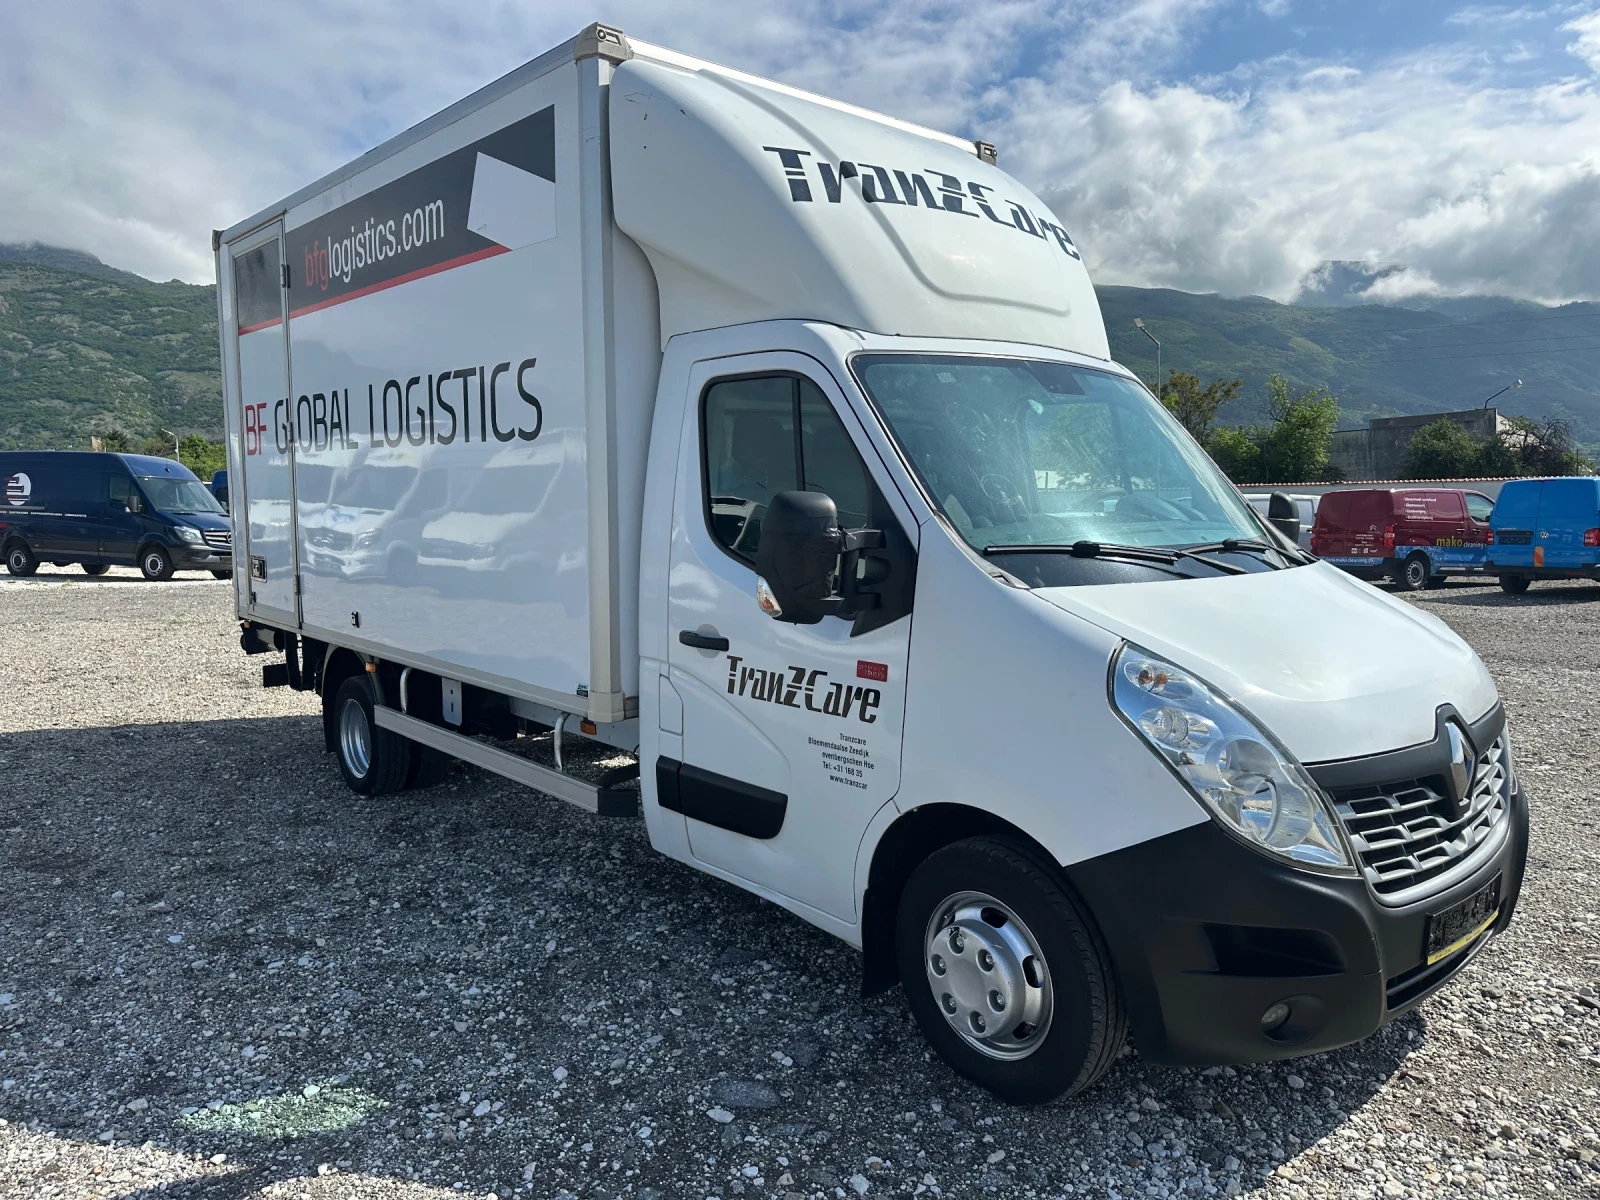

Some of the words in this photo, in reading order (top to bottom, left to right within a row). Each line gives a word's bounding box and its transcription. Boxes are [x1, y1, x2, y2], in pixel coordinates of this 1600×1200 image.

[304, 198, 445, 291] bfglogistics.com
[244, 402, 268, 456] BF
[368, 357, 544, 449] LOGISTICS
[1436, 535, 1463, 547] mako
[1463, 541, 1484, 550] cleaning
[807, 736, 849, 753] Bloemendaalse
[839, 732, 867, 746] Tranzcare
[833, 764, 843, 773] +31
[845, 767, 855, 776] 168
[855, 769, 863, 778] 35
[829, 774, 868, 790] www.tranzcar
